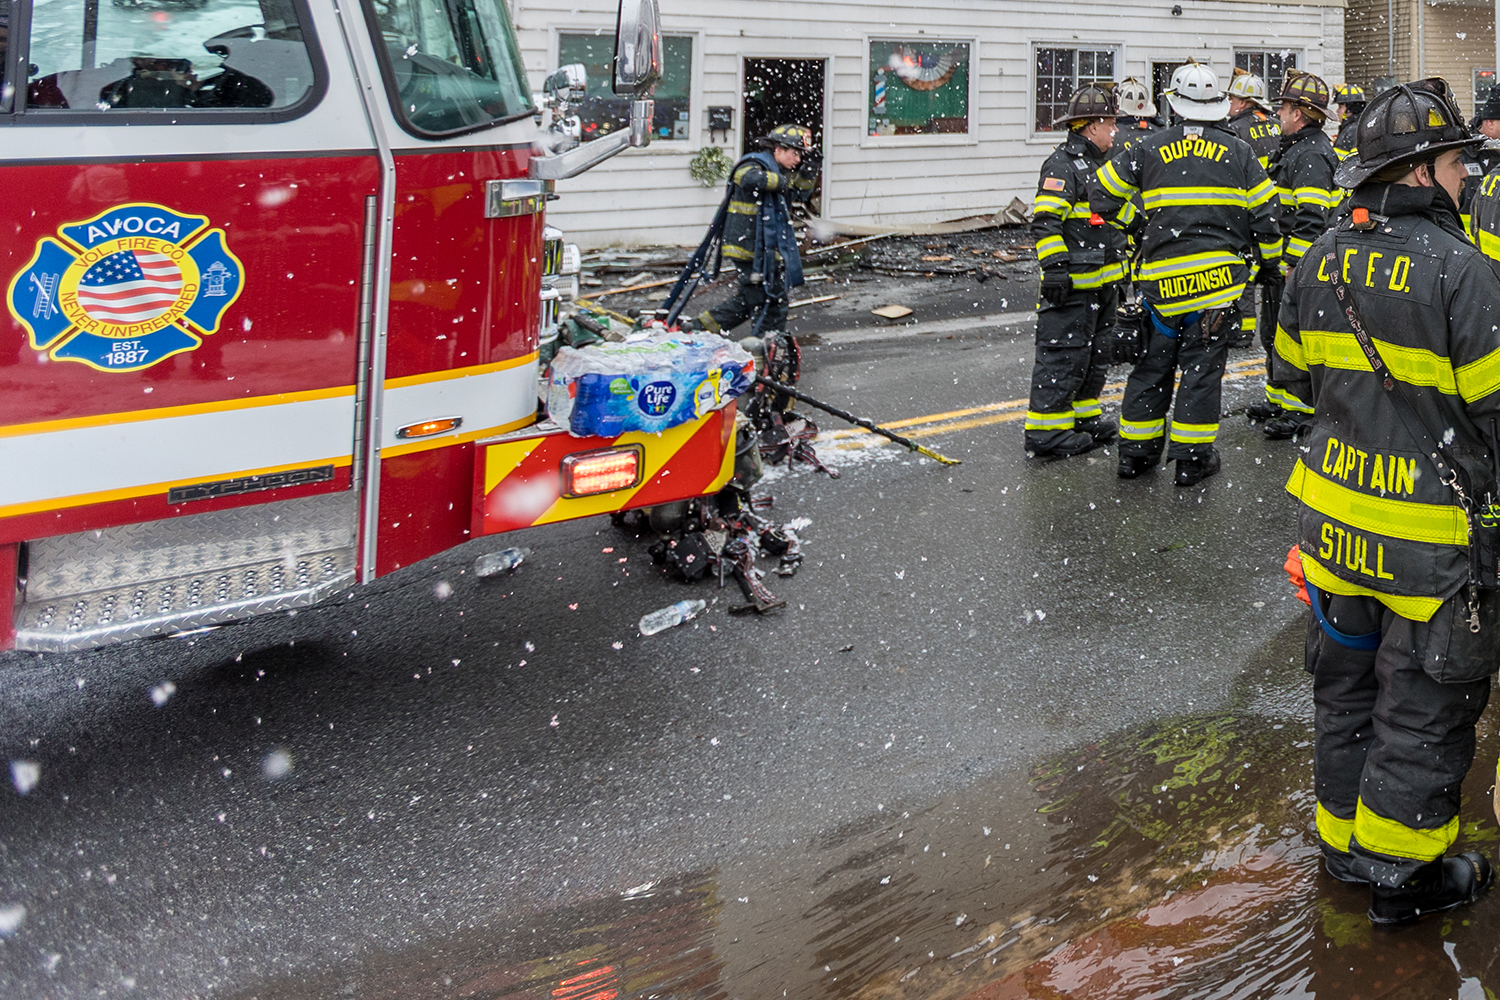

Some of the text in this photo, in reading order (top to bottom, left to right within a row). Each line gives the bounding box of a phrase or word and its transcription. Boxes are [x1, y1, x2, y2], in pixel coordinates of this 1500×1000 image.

[1159, 139, 1229, 164] DUPONT
[87, 216, 181, 243] AVOCA
[75, 237, 185, 270] VOL. FIRE CO.
[1158, 265, 1234, 299] HUDZINSKI
[61, 283, 198, 337] NEVER UNPREPARED
[112, 340, 144, 352] EST.
[1345, 305, 1383, 371] STULL
[104, 350, 149, 366] 1887
[644, 384, 673, 397] Pure
[646, 392, 670, 405] Life
[1322, 437, 1417, 495] CAPTAIN
[173, 468, 331, 499] TYPHOON
[1319, 522, 1394, 581] STULL
